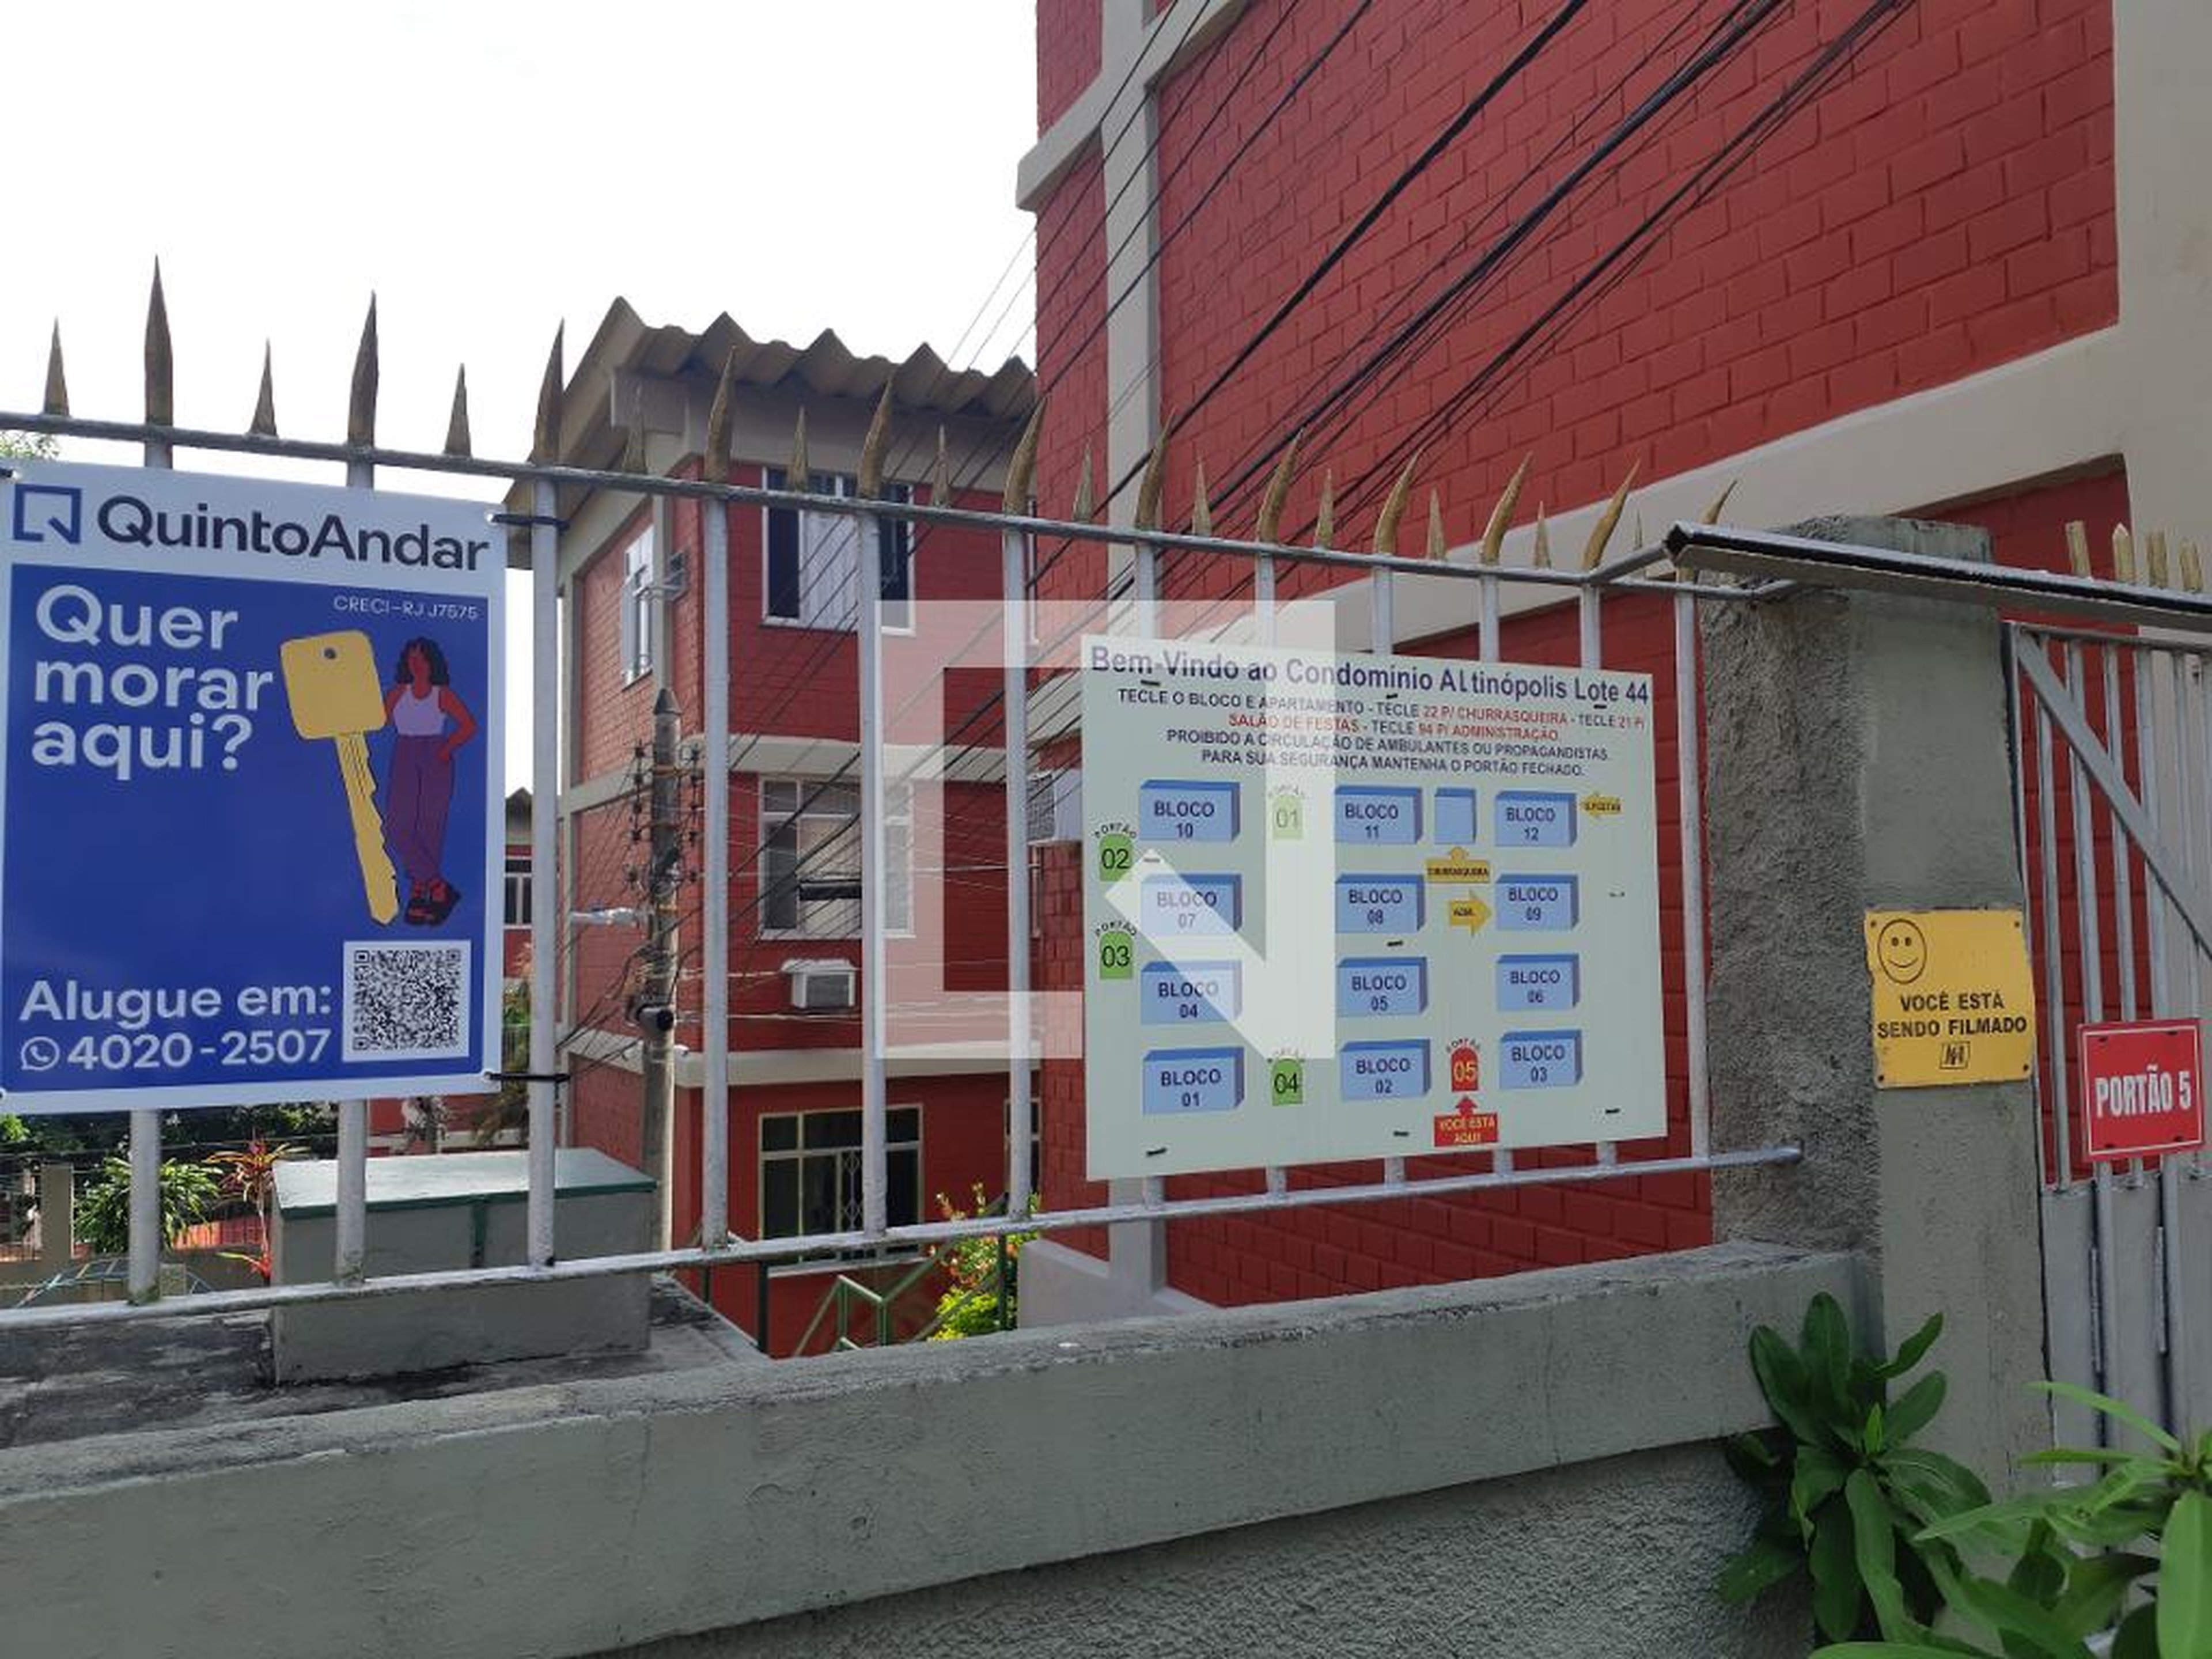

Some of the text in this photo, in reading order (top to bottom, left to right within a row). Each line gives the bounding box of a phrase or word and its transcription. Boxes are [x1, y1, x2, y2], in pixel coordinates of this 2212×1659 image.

[97, 495, 490, 571] QuintoAndar
[334, 595, 424, 616] CRECI-RJ
[36, 584, 238, 650] Quer
[1092, 646, 1239, 679] Bem-Vindo
[1248, 662, 1277, 681] ao
[1575, 677, 1619, 702] Lote
[1626, 681, 1649, 705] 44
[35, 660, 273, 711] morar
[1118, 688, 1169, 705] TECLE
[1172, 691, 1184, 705] O
[1189, 692, 1241, 707] BLOCO
[1246, 695, 1256, 709] E
[1259, 696, 1364, 714] APARTAMENTO
[1377, 701, 1419, 718] TECLE
[1423, 705, 1438, 718] 22
[1457, 706, 1567, 725] CHURRASQUEIRA
[1228, 712, 1278, 728] SALÃO
[1283, 716, 1302, 729] DE
[1306, 717, 1360, 733] FESTAS
[1372, 719, 1415, 735] TECLE
[32, 713, 252, 781] aqui?
[1166, 729, 1241, 745] PROIBIDO
[1244, 732, 1255, 745] A
[1355, 736, 1374, 749] DE
[1472, 741, 1492, 755] OU
[1202, 749, 1243, 764] PARA
[1245, 751, 1275, 766] SUA
[1280, 752, 1369, 770] SEGURANÇA
[1372, 755, 1448, 771] MANTENHA
[1450, 760, 1461, 772] O
[1464, 757, 1518, 774] PORTÃO
[1154, 801, 1215, 818] BLOCO
[1345, 804, 1399, 820] BLOCO
[1506, 806, 1555, 823] BLOCO
[1276, 808, 1297, 829] 01
[1176, 823, 1194, 838] 10
[1365, 825, 1379, 839] 11
[1524, 827, 1539, 842] 12
[1101, 849, 1131, 869] 02
[1156, 891, 1217, 908] BLOCO
[1349, 889, 1403, 905] BLOCO
[1508, 887, 1559, 903] BLOCO
[1178, 914, 1196, 928] 07
[1367, 909, 1384, 925] 08
[1526, 906, 1542, 922] 09
[1101, 946, 1130, 968] 03
[1351, 975, 1407, 991] BLOCO
[1510, 970, 1561, 985] BLOCO
[1158, 982, 1219, 998] BLOCO
[1527, 990, 1544, 1004] 06
[20, 980, 332, 1030] Alugue em:
[1370, 995, 1388, 1012] 05
[1900, 990, 2005, 1012] VOCÊ ESTÁ
[1179, 1004, 1198, 1018] 04
[1877, 1016, 2027, 1039] SENDO FILMADO
[1512, 1044, 1566, 1062] BLOCO
[1355, 1058, 1411, 1075] BLOCO
[1454, 1061, 1478, 1083] 05
[1531, 1066, 1548, 1083] 03
[1160, 1069, 1222, 1086] BLOCO
[1274, 1073, 1300, 1094] 04
[1375, 1079, 1393, 1094] 02
[2094, 1065, 2191, 1118] PORTÃO 5
[1181, 1092, 1201, 1107] 01
